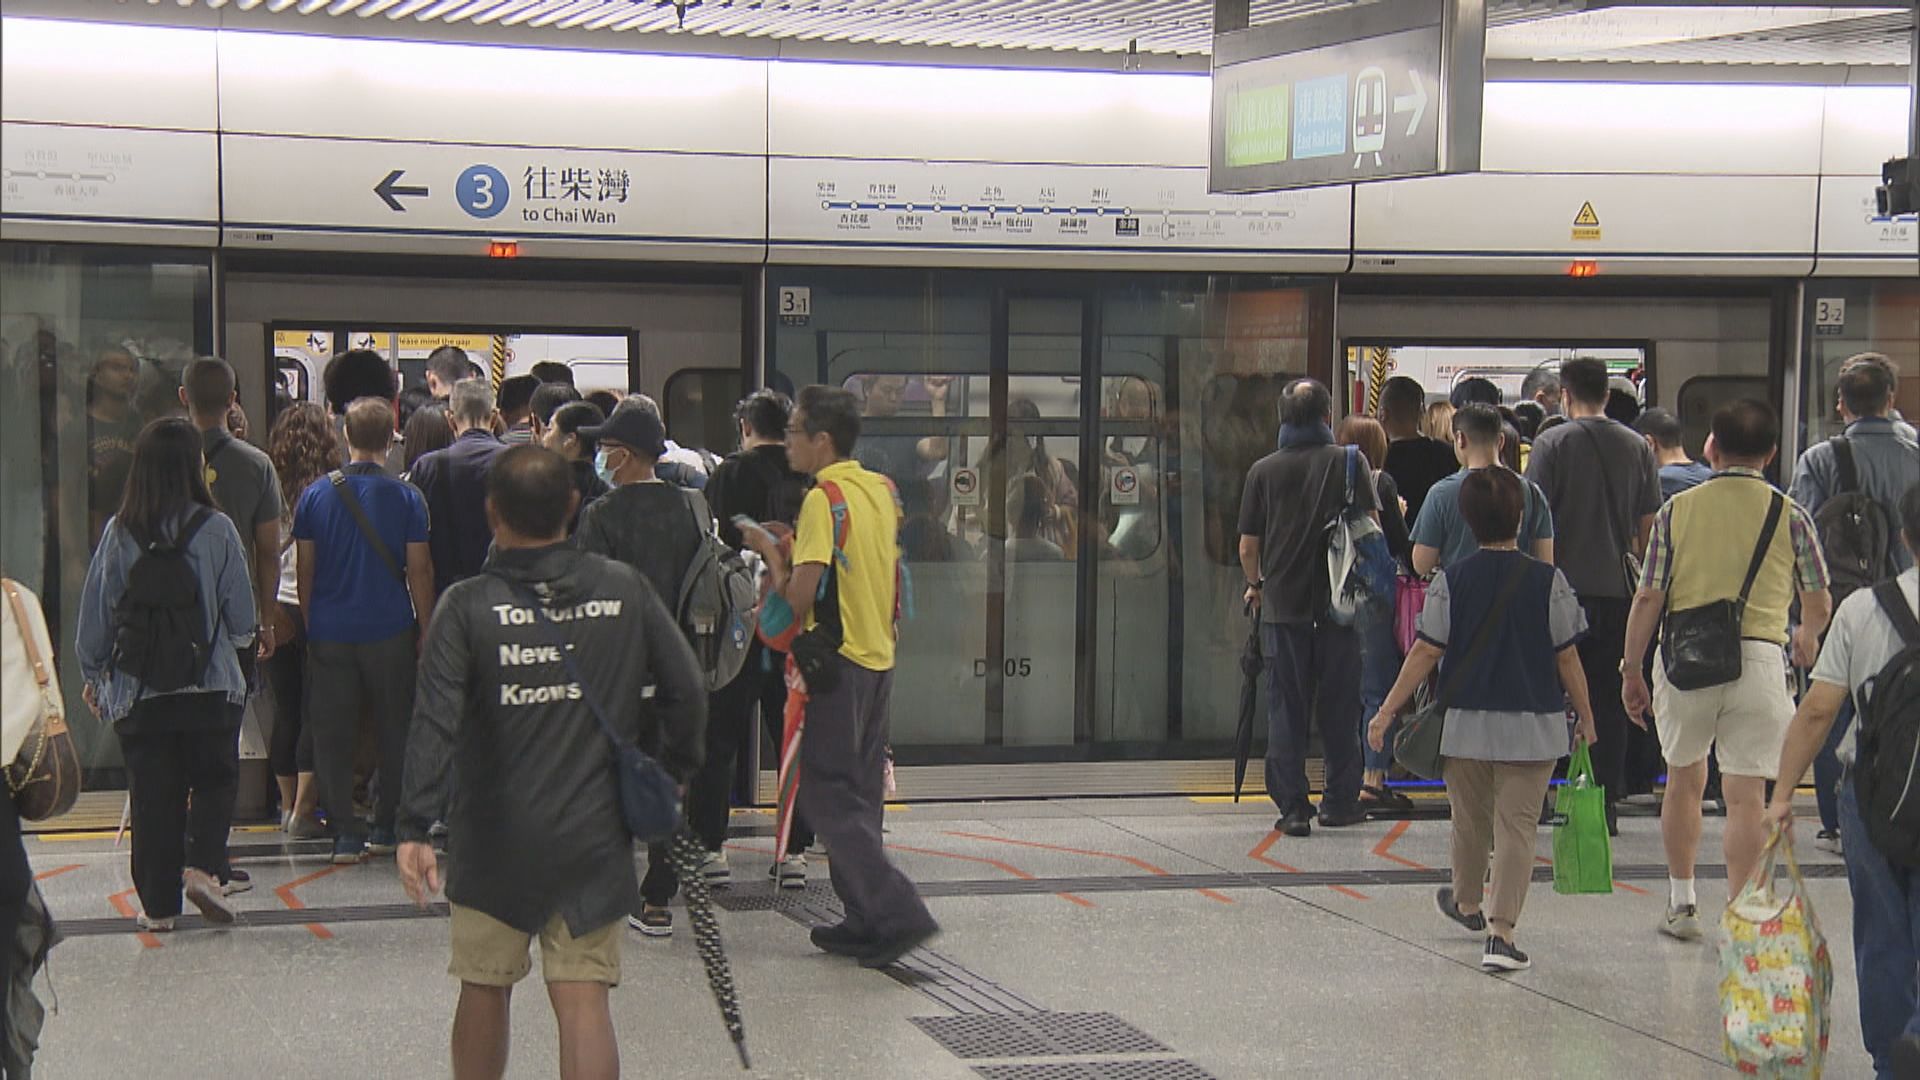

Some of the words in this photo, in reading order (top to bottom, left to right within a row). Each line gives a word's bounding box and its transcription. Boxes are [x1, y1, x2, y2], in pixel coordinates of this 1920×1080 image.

[472, 174, 494, 210] 3
[523, 165, 630, 203] 往柴灣
[522, 208, 539, 221] to
[543, 207, 578, 222] Chai
[582, 208, 616, 223] Wan
[441, 336, 454, 345] the
[499, 643, 576, 666] Neve
